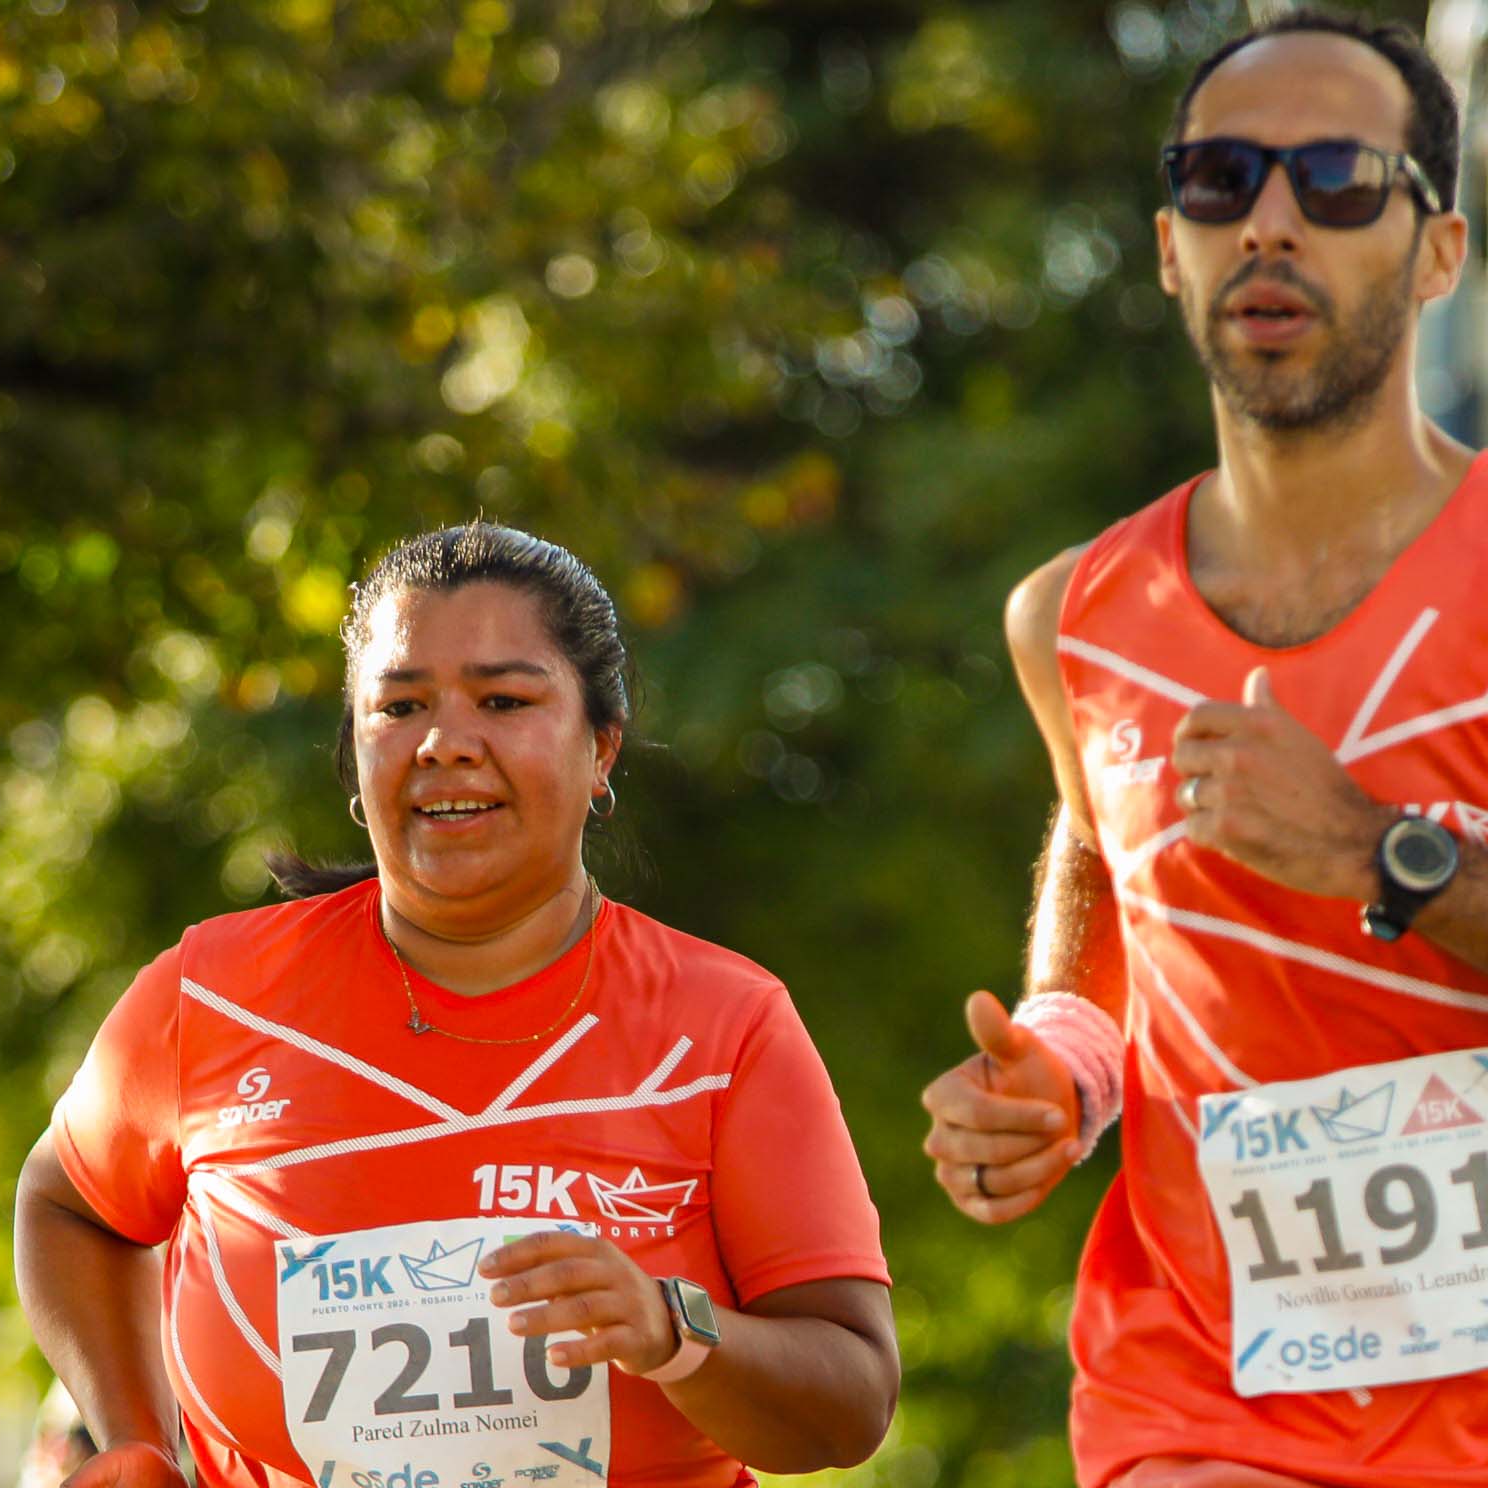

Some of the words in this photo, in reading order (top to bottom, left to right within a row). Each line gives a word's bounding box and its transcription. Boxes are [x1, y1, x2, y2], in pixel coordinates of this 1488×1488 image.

[1417, 1099, 1463, 1124] 15K
[1231, 1108, 1309, 1161] 15K
[473, 1164, 581, 1217] 15K
[312, 1256, 395, 1301] 15K
[1277, 1286, 1340, 1310] Novillo
[1343, 1277, 1412, 1301] Gonzalo
[312, 1305, 350, 1315] PUERTO
[352, 1302, 384, 1312] NORTE
[292, 1316, 593, 1424] 7216
[1280, 1325, 1382, 1371] osde
[352, 1424, 403, 1443] Pared
[409, 1416, 470, 1438] Zulma
[475, 1410, 538, 1433] Nomei
